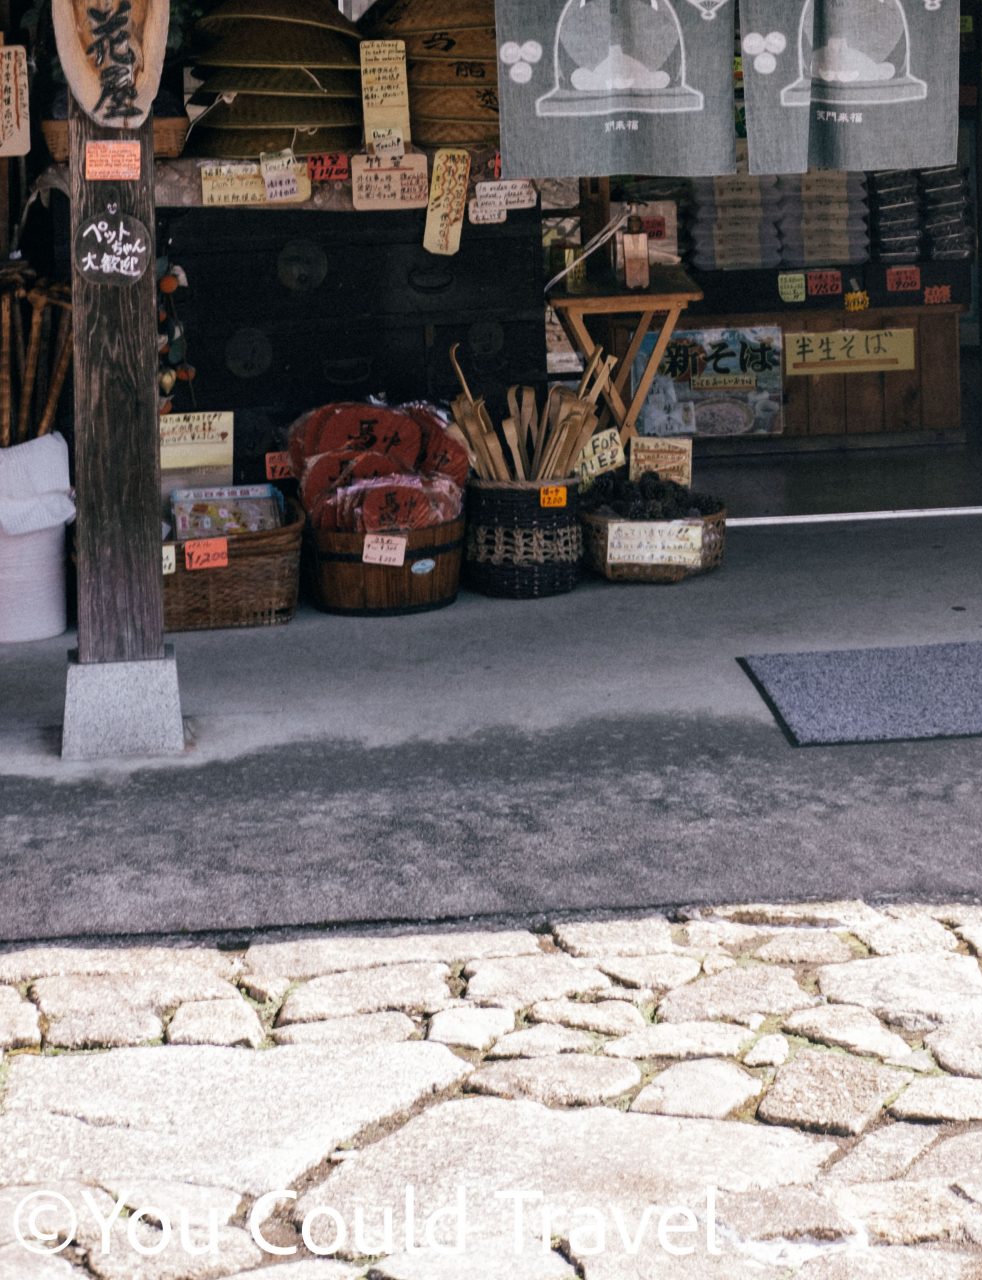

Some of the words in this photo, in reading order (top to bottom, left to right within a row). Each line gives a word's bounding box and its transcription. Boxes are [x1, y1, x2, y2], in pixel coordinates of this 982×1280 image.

[82, 221, 131, 245] ペット
[111, 238, 147, 256] ちゃん
[82, 251, 141, 277] 大歓迎
[665, 339, 773, 376] 新そば
[795, 331, 894, 362] 半生そば
